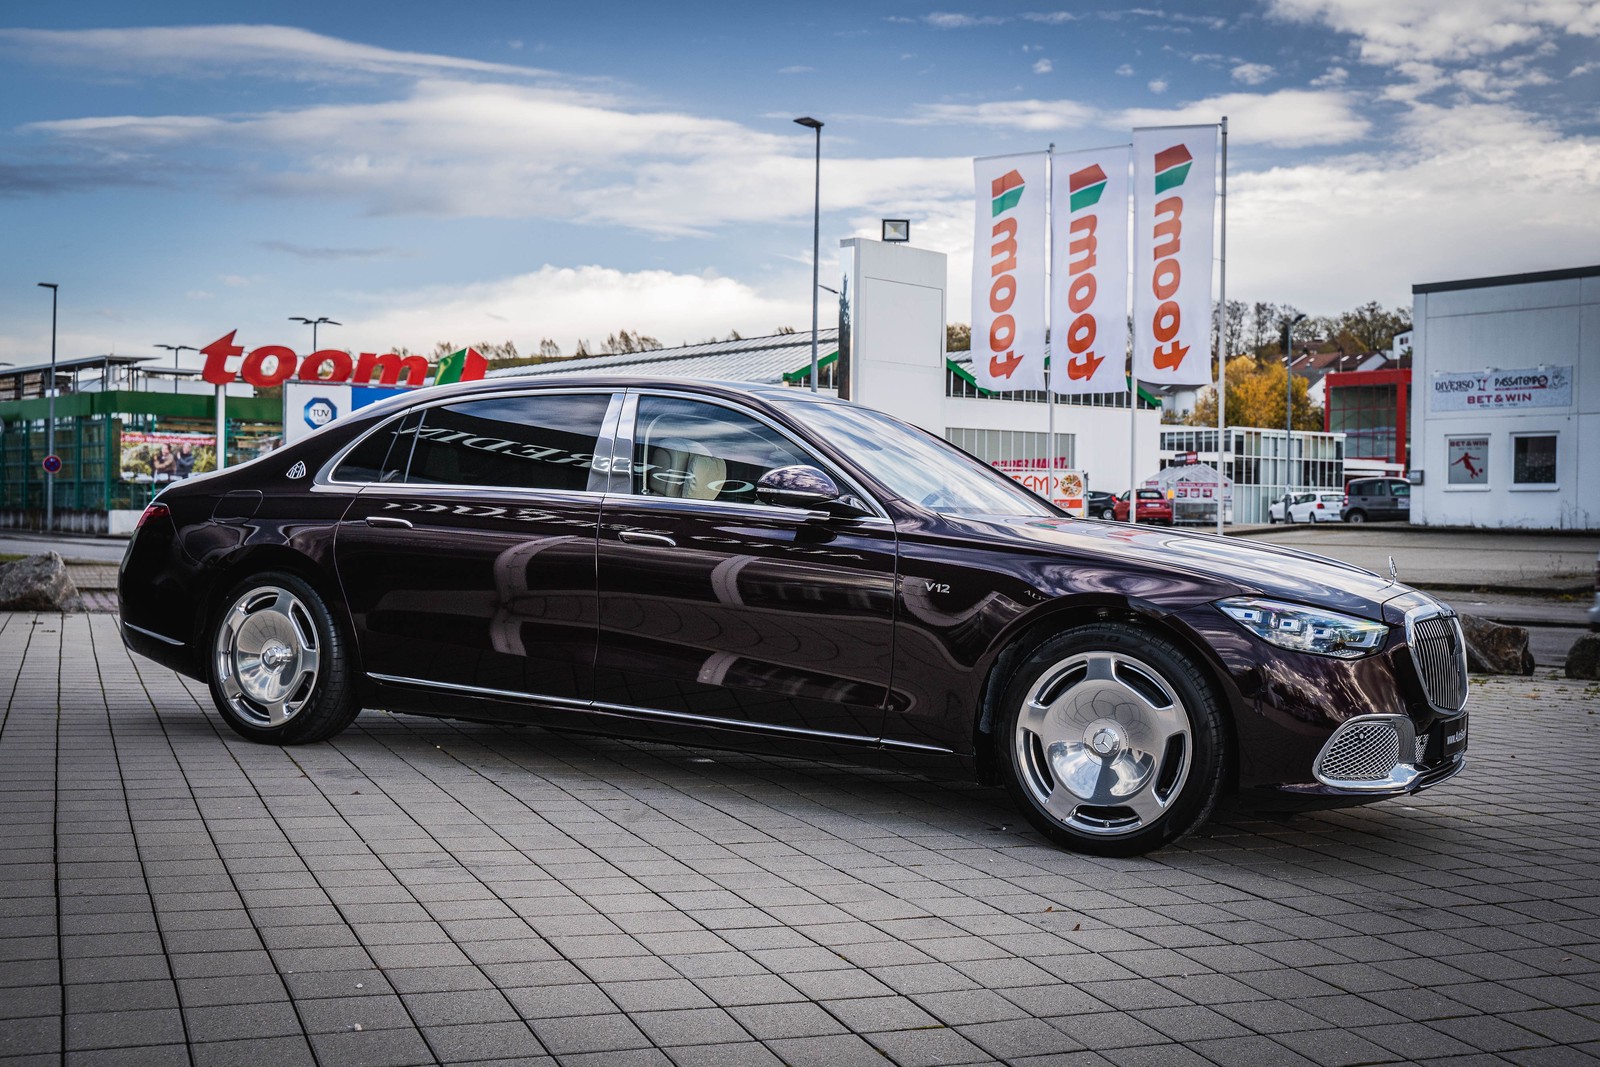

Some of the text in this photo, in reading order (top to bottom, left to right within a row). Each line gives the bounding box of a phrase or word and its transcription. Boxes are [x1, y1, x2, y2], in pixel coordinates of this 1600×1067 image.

[199, 329, 429, 387] toom
[989, 217, 1024, 380] toom
[1067, 214, 1106, 381] toom
[1152, 196, 1191, 372] toom
[925, 581, 951, 594] V12
